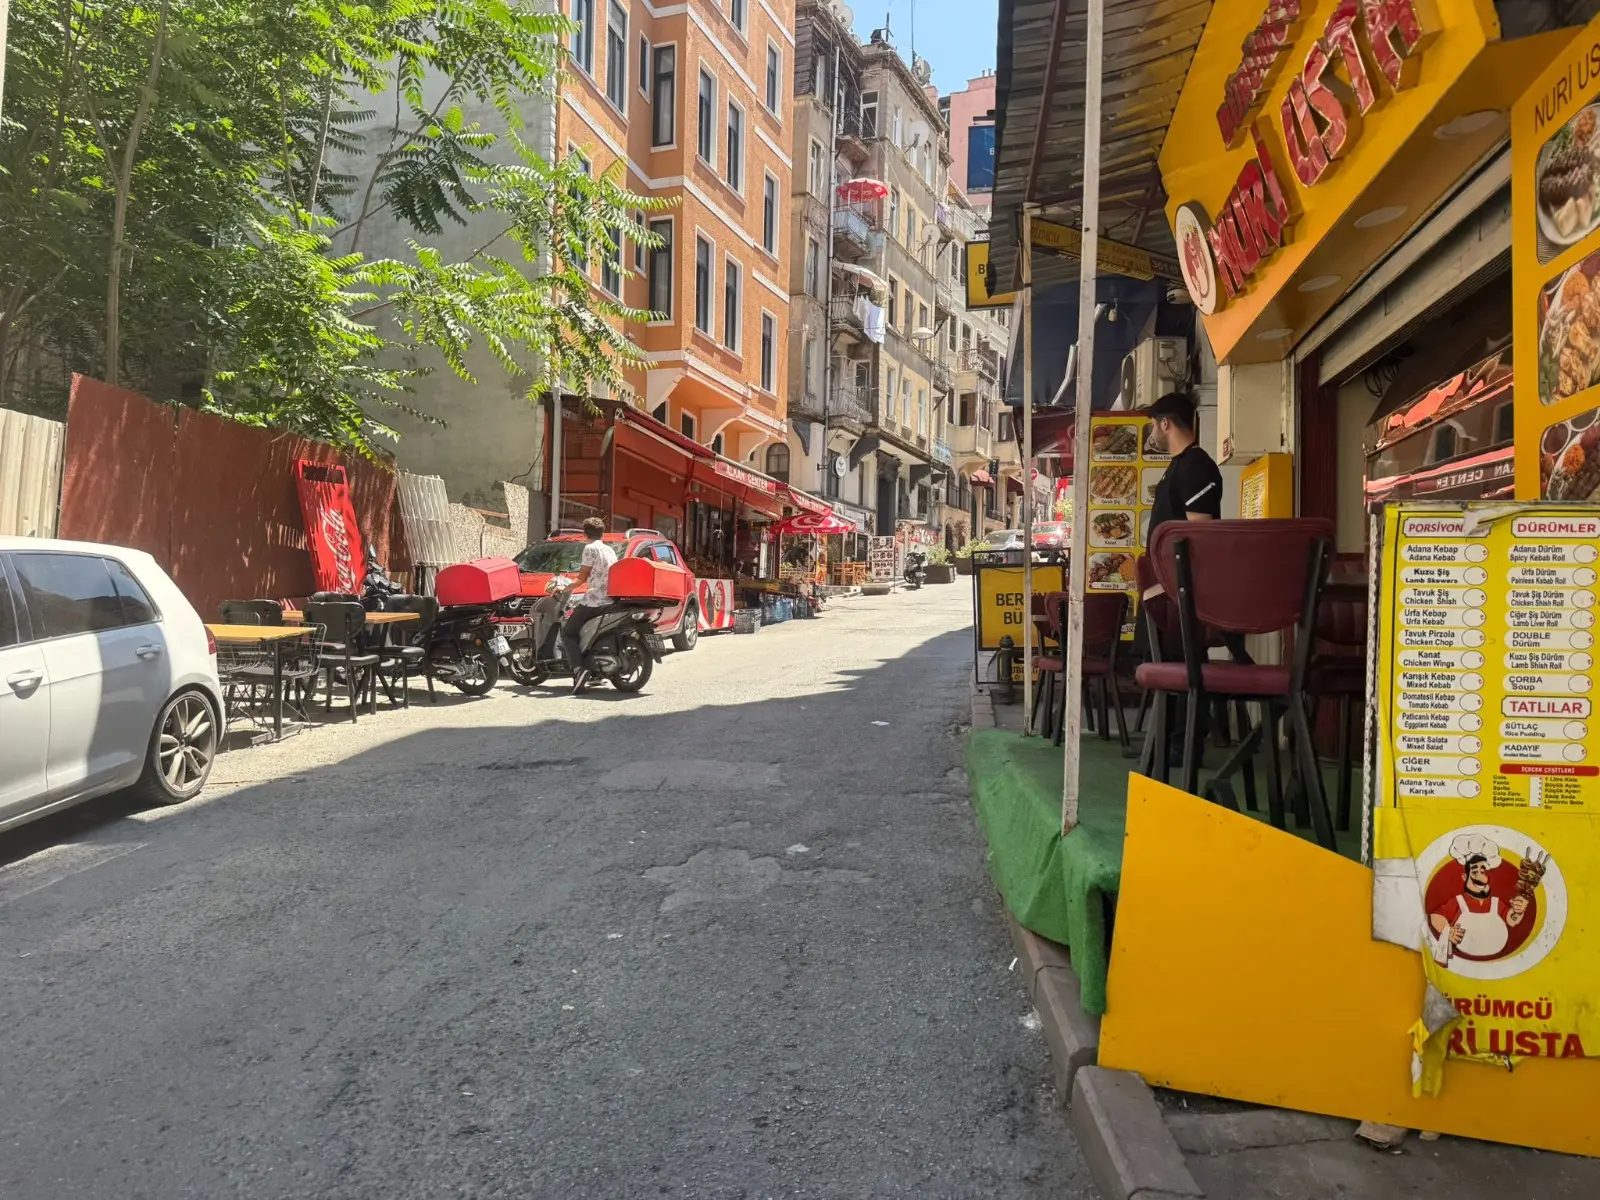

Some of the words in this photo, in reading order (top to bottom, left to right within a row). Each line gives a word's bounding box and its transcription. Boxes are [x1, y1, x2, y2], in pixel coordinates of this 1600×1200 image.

[1534, 63, 1572, 134] NURİ
[1518, 522, 1596, 532] DÜRÜMLER
[1434, 545, 1458, 554] Kebap
[1437, 589, 1449, 598] Şiş
[1433, 660, 1454, 668] Wings
[1403, 672, 1429, 680] Karışık
[1431, 673, 1455, 681] Kebap
[1509, 676, 1542, 685] ÇORBA
[1435, 693, 1455, 702] Kebap
[1510, 701, 1582, 713] TATLILAR
[1431, 714, 1450, 722] Kebap
[1489, 1029, 1586, 1058] USTA
